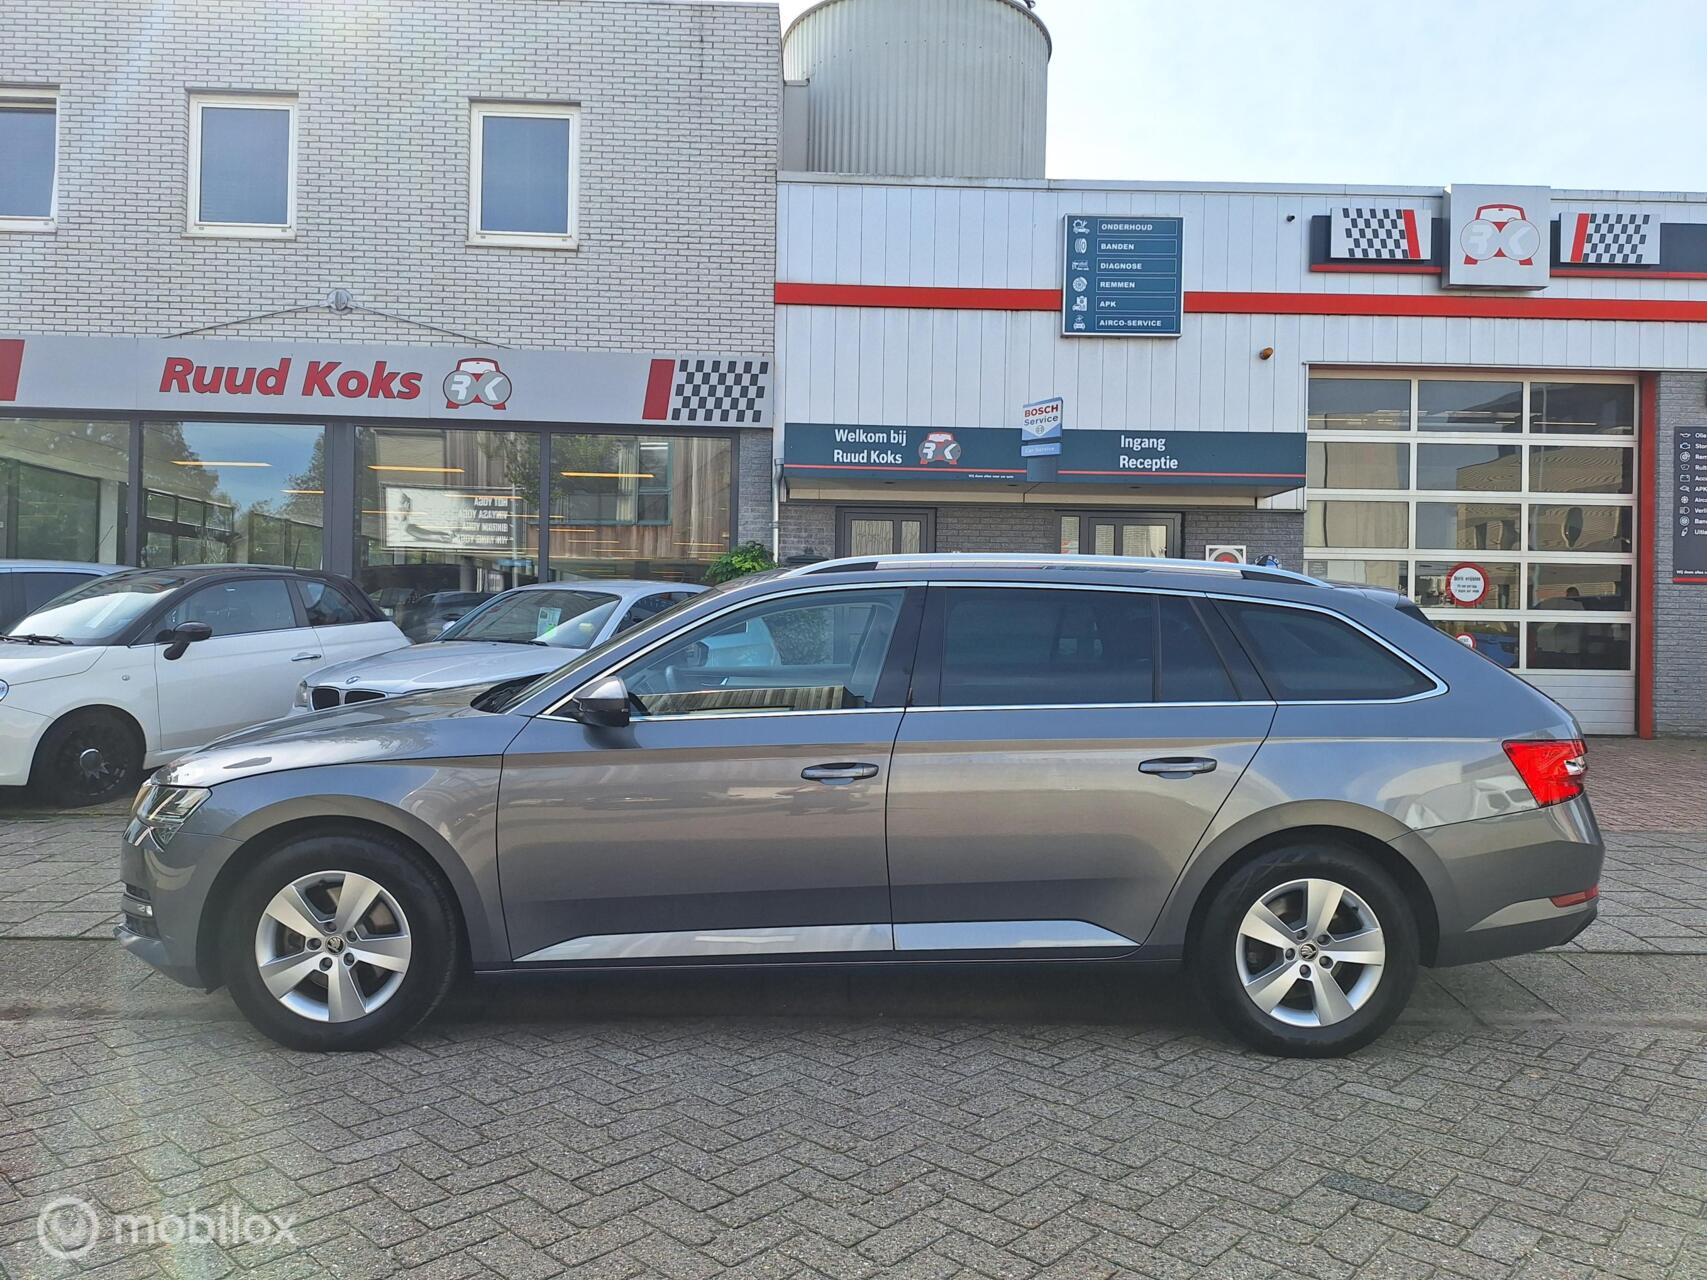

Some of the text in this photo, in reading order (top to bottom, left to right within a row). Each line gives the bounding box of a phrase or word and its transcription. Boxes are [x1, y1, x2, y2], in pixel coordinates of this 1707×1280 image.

[1101, 223, 1153, 231] ONDERHOUD
[159, 357, 423, 400] Ruud Koks
[1024, 404, 1059, 418] BOSCH
[1024, 415, 1059, 427] Service
[834, 428, 907, 447] Welkom bij
[1120, 434, 1167, 452] Ingang
[833, 449, 903, 464] Ruud Koks
[1119, 455, 1179, 472] Receptie
